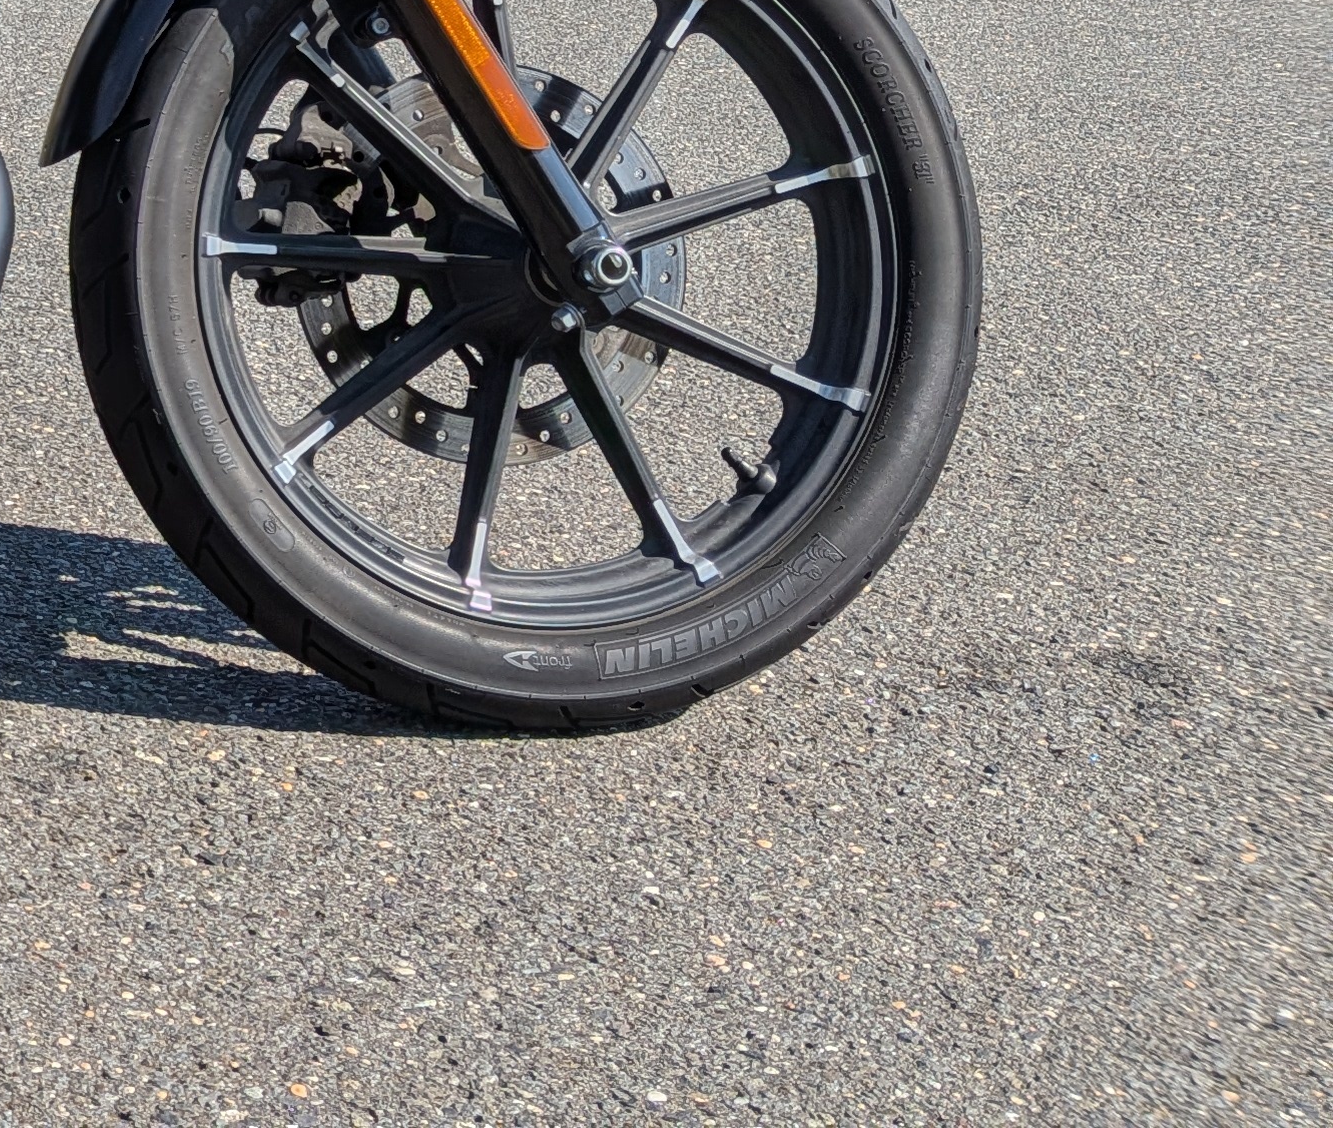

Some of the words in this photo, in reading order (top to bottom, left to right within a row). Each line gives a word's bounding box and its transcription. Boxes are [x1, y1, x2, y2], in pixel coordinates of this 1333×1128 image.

[853, 36, 923, 151] SCORCHER
[197, 413, 239, 474] 100/90
[534, 652, 573, 670] front
[605, 575, 797, 675] MICHELIN
